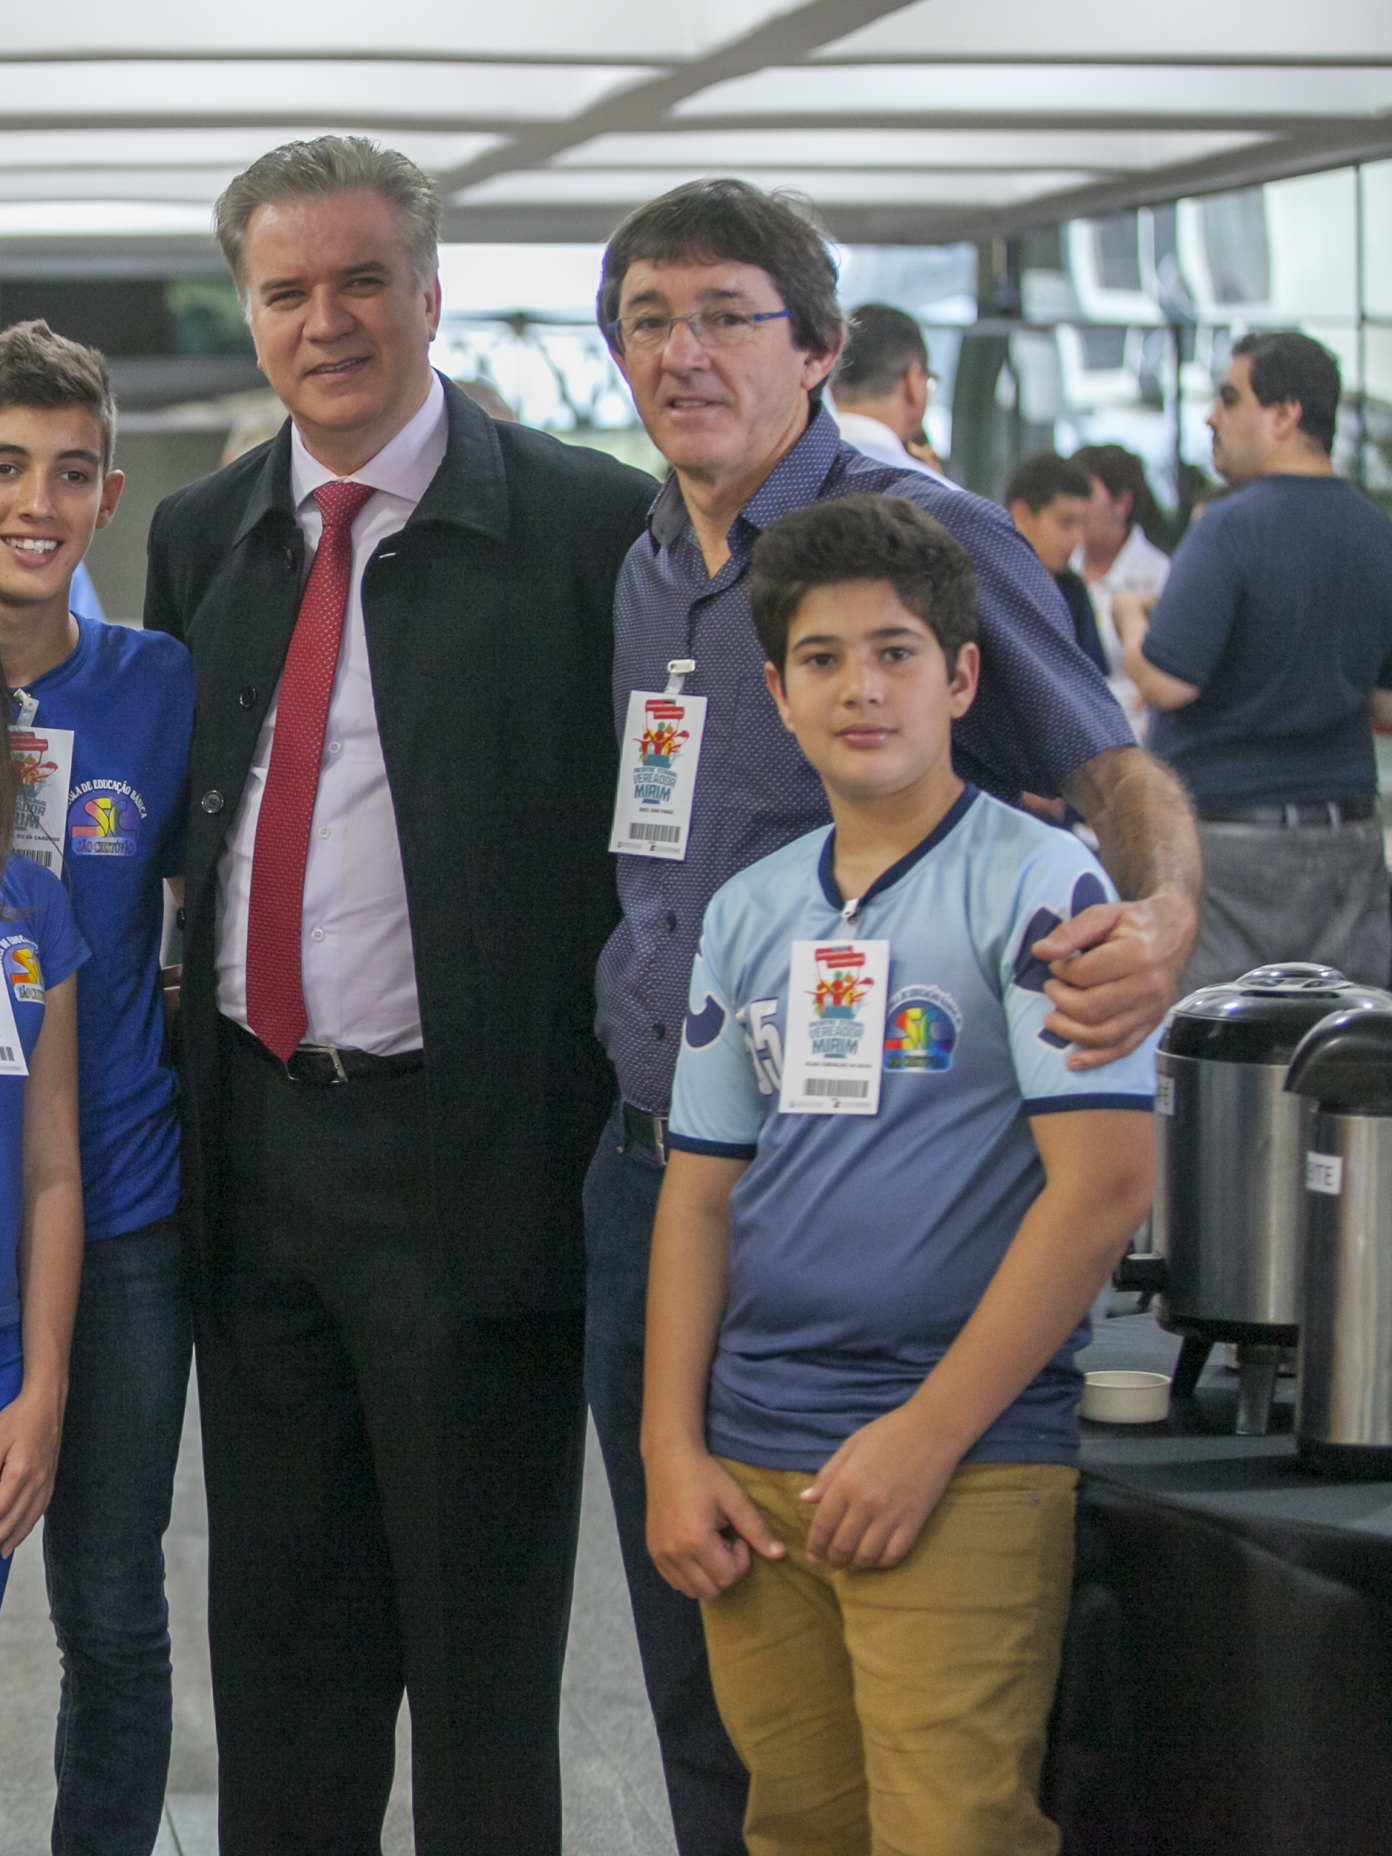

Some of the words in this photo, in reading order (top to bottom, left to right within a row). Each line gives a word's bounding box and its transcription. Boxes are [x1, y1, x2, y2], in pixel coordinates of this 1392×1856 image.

[633, 773, 677, 788] VEREADOR
[80, 781, 93, 793] DE
[93, 779, 131, 796] EDUCAÇÃO
[130, 789, 148, 819] BÁSICA
[634, 784, 671, 802] MIRIM
[812, 1038, 858, 1055] MIRIM
